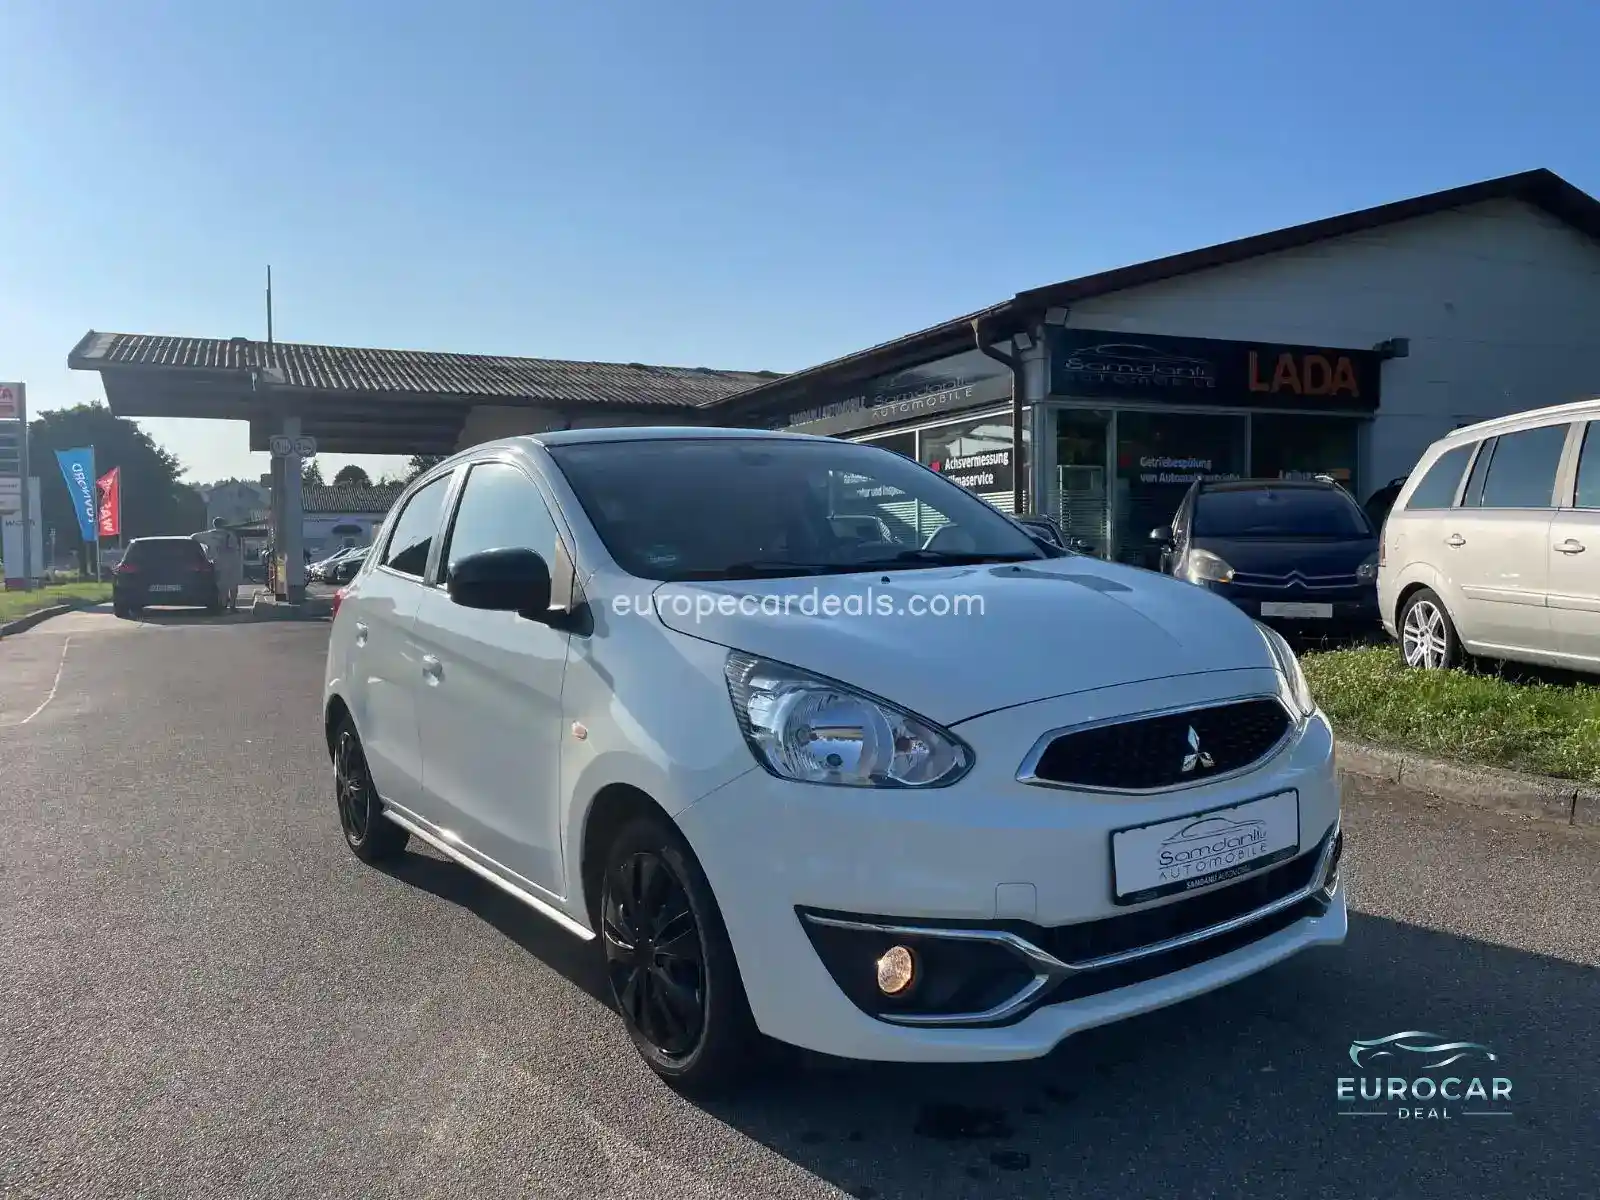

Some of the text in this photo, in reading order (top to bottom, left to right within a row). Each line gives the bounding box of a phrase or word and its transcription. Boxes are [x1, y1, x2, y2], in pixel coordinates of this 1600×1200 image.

[1249, 351, 1359, 397] LADA
[872, 388, 973, 419] AUTOMOBILE
[945, 452, 1009, 471] Achsvermessung
[948, 471, 994, 488] imaservice
[1159, 844, 1268, 881] AUTOMOBILE
